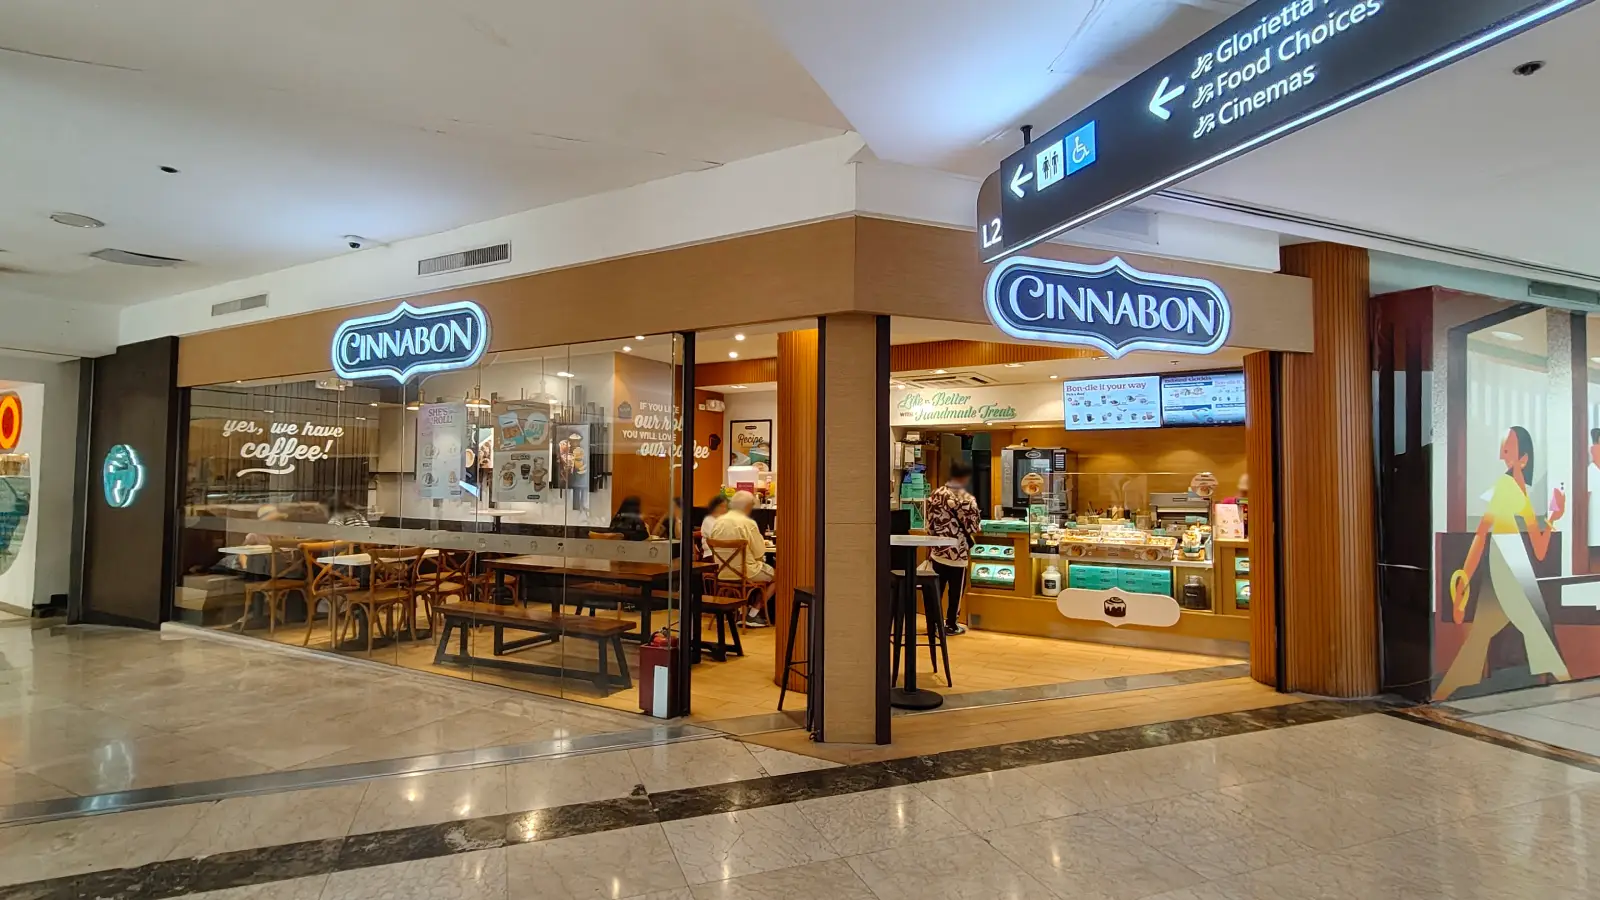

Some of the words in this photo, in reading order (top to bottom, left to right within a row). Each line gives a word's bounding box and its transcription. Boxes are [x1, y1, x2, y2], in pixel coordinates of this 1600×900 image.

[1216, 0, 1314, 63] Glorietta
[1217, 49, 1271, 96] Food
[1278, 0, 1382, 62] Choices
[1218, 64, 1316, 125] Cinemas
[982, 218, 1002, 249] L2
[1009, 275, 1215, 336] CINNABON
[341, 318, 472, 366] CINNABON
[1107, 383, 1126, 391] your
[1128, 382, 1147, 390] way
[649, 403, 664, 412] YOU
[932, 392, 971, 406] Better
[978, 403, 1017, 421] Treats
[222, 419, 264, 437] yes,
[270, 422, 299, 435] we
[301, 422, 344, 437] have
[634, 414, 660, 430] our
[623, 429, 638, 439] YOU
[640, 431, 657, 440] WILL
[737, 433, 764, 447] Recipe
[240, 437, 334, 467] coffee!
